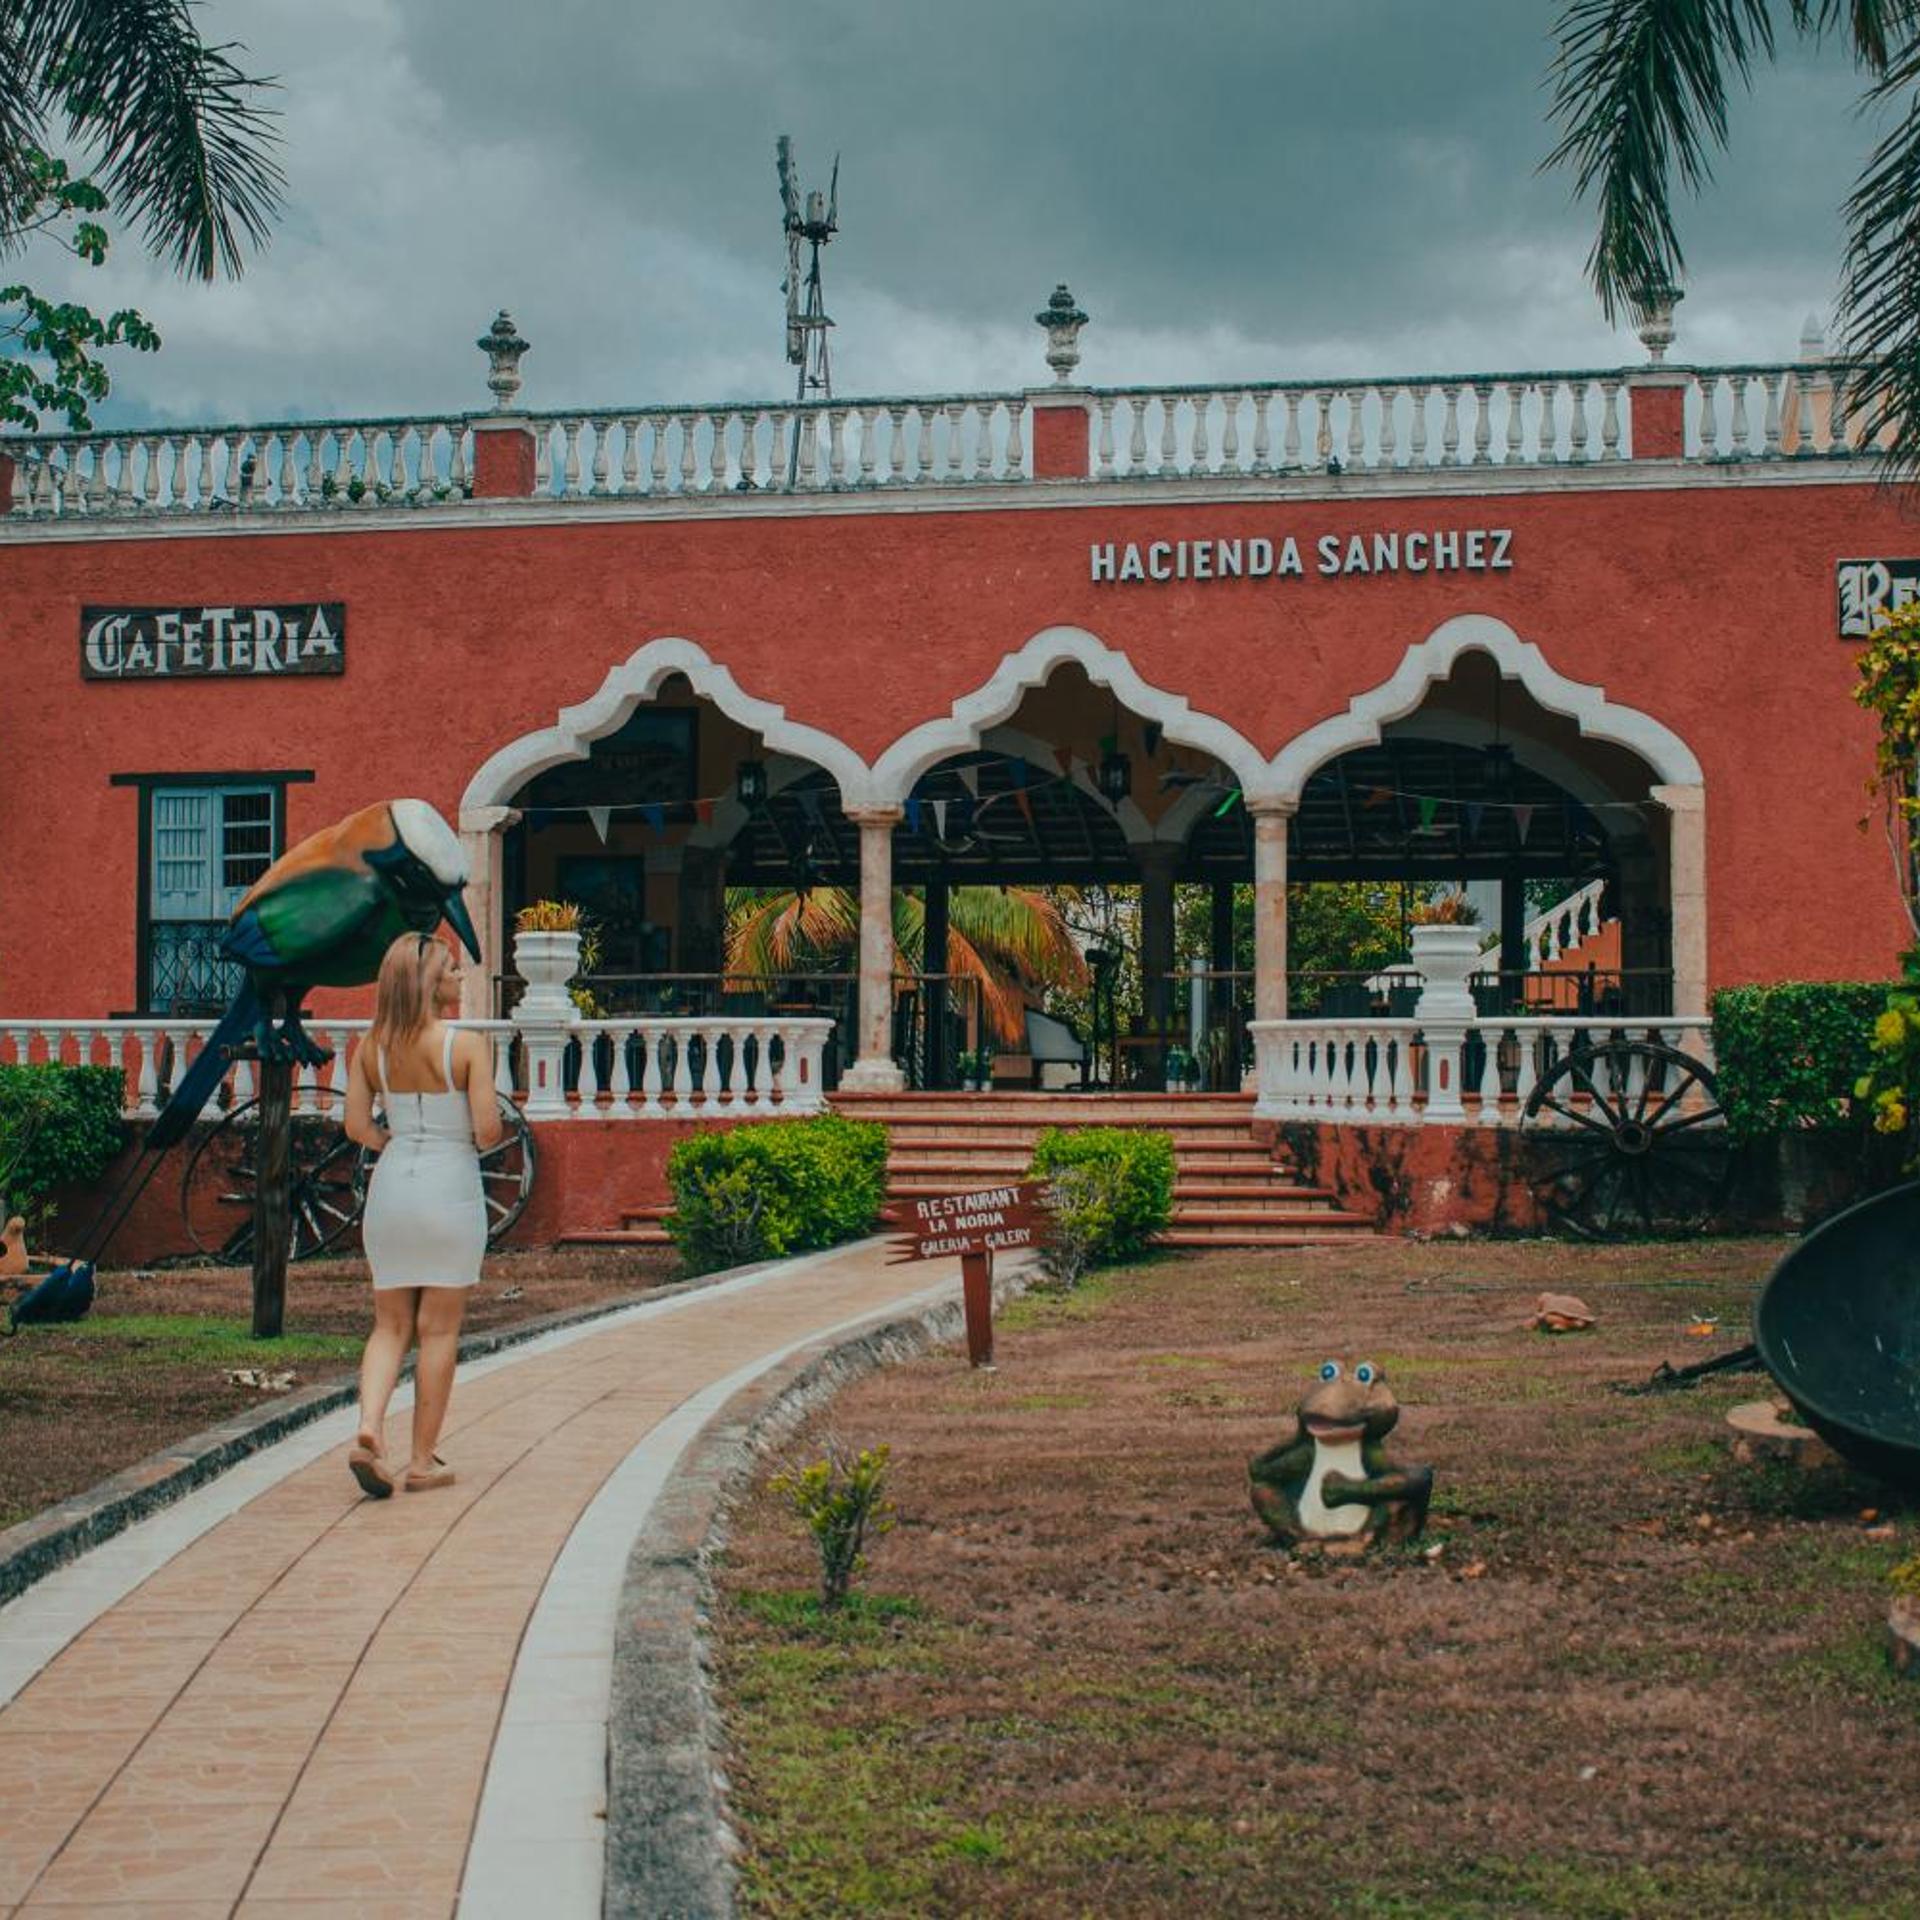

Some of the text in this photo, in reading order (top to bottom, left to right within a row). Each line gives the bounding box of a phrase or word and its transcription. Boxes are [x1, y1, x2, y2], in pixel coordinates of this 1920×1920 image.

[1091, 529, 1513, 581] HACIENDA SANCHEZ
[1839, 562, 1920, 634] RE
[916, 1187, 1021, 1219] RESTAURANT
[929, 1212, 1005, 1233] LA NORIA
[920, 1236, 971, 1258] GALERIA
[984, 1228, 1031, 1249] GALERY
